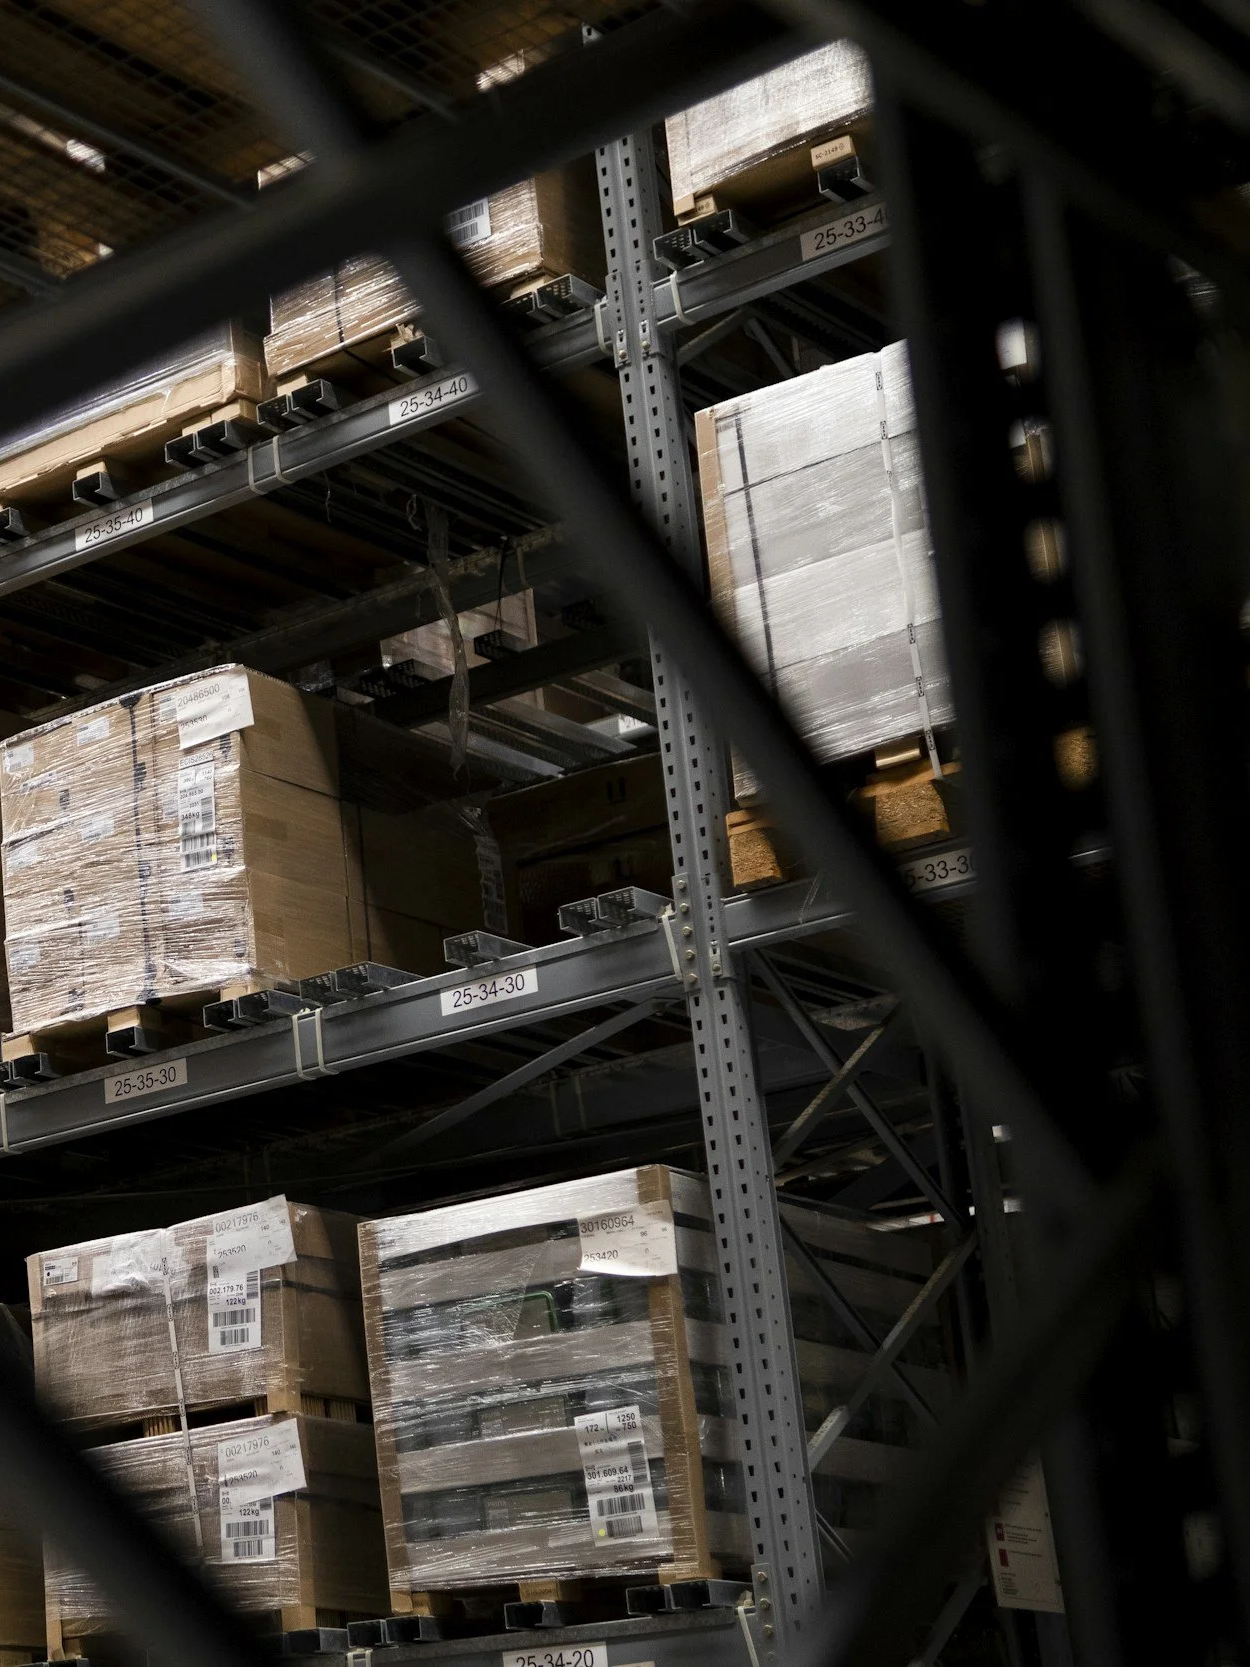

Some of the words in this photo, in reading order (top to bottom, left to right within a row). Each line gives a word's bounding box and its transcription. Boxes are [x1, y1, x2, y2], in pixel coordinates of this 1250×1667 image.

[814, 207, 890, 250] 25-33-4
[400, 376, 468, 417] 25-34-40
[84, 507, 143, 543] 25-35-40
[177, 683, 220, 708] 20486500
[904, 855, 972, 889] 5-33-3
[452, 973, 525, 1008] 25-34-30
[114, 1066, 177, 1096] 25-35-30
[215, 1212, 258, 1233] 00217976
[579, 1215, 635, 1234] 30160964
[583, 1249, 619, 1263] 253420
[209, 1283, 244, 1295] 002.179.76
[226, 1297, 246, 1306] 122kg
[616, 1412, 636, 1423] 1250
[622, 1421, 637, 1431] 750
[585, 1424, 599, 1434] 172
[225, 1436, 270, 1458] 00217976
[586, 1465, 629, 1480] 301.609.64
[239, 1507, 260, 1517] 122kg
[516, 1649, 594, 1667] 25-34-20
